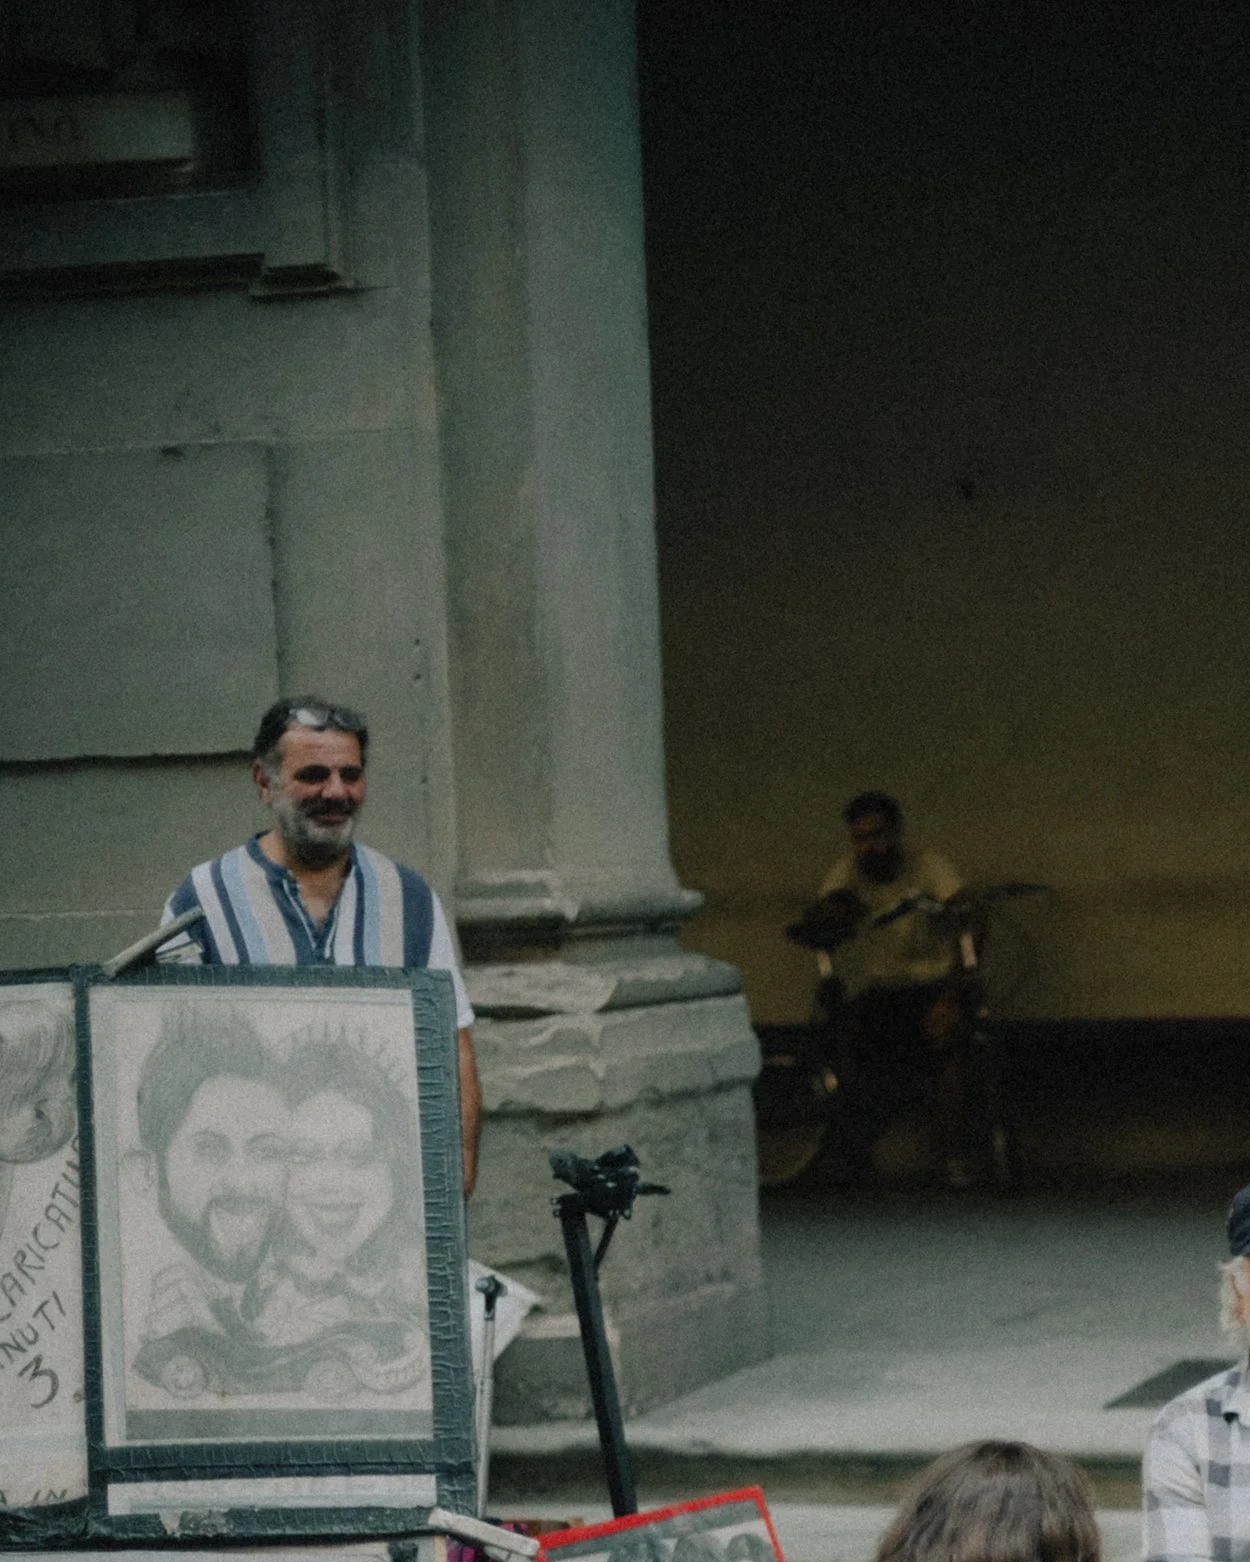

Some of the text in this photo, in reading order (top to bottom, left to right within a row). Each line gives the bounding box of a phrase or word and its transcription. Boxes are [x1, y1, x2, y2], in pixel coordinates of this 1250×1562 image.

[0, 1134, 81, 1323] ARICATU
[0, 1290, 66, 1370] NUTI
[18, 1354, 60, 1410] 3
